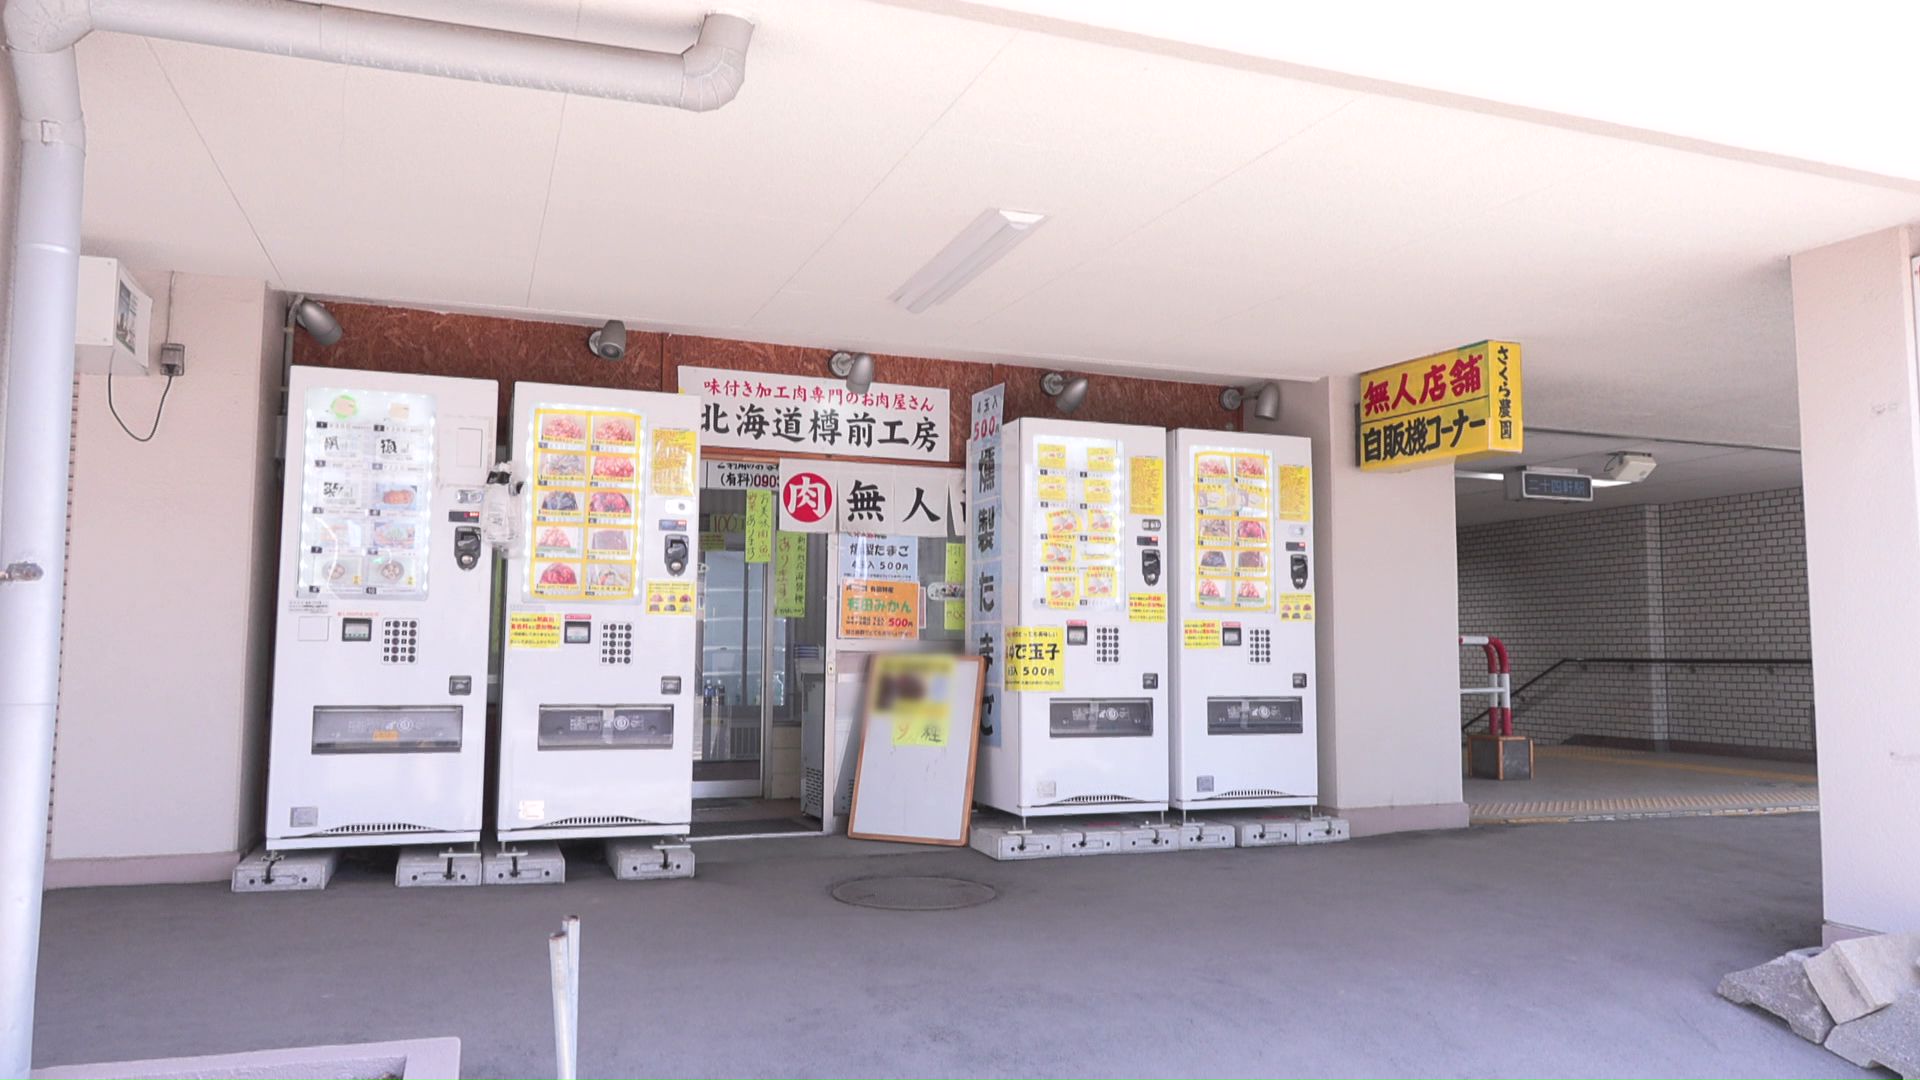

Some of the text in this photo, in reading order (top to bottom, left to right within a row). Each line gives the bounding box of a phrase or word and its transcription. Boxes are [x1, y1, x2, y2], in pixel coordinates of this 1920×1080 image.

[703, 378, 935, 412] 味付き加工肉専門のお肉屋さん
[1363, 354, 1483, 417] 無人店舗
[700, 402, 939, 452] 北海道樽前工房
[1363, 408, 1486, 462] 自販機コーナー
[721, 472, 779, 488] (有料)090
[787, 475, 826, 518] 肉
[846, 479, 966, 523] 無人
